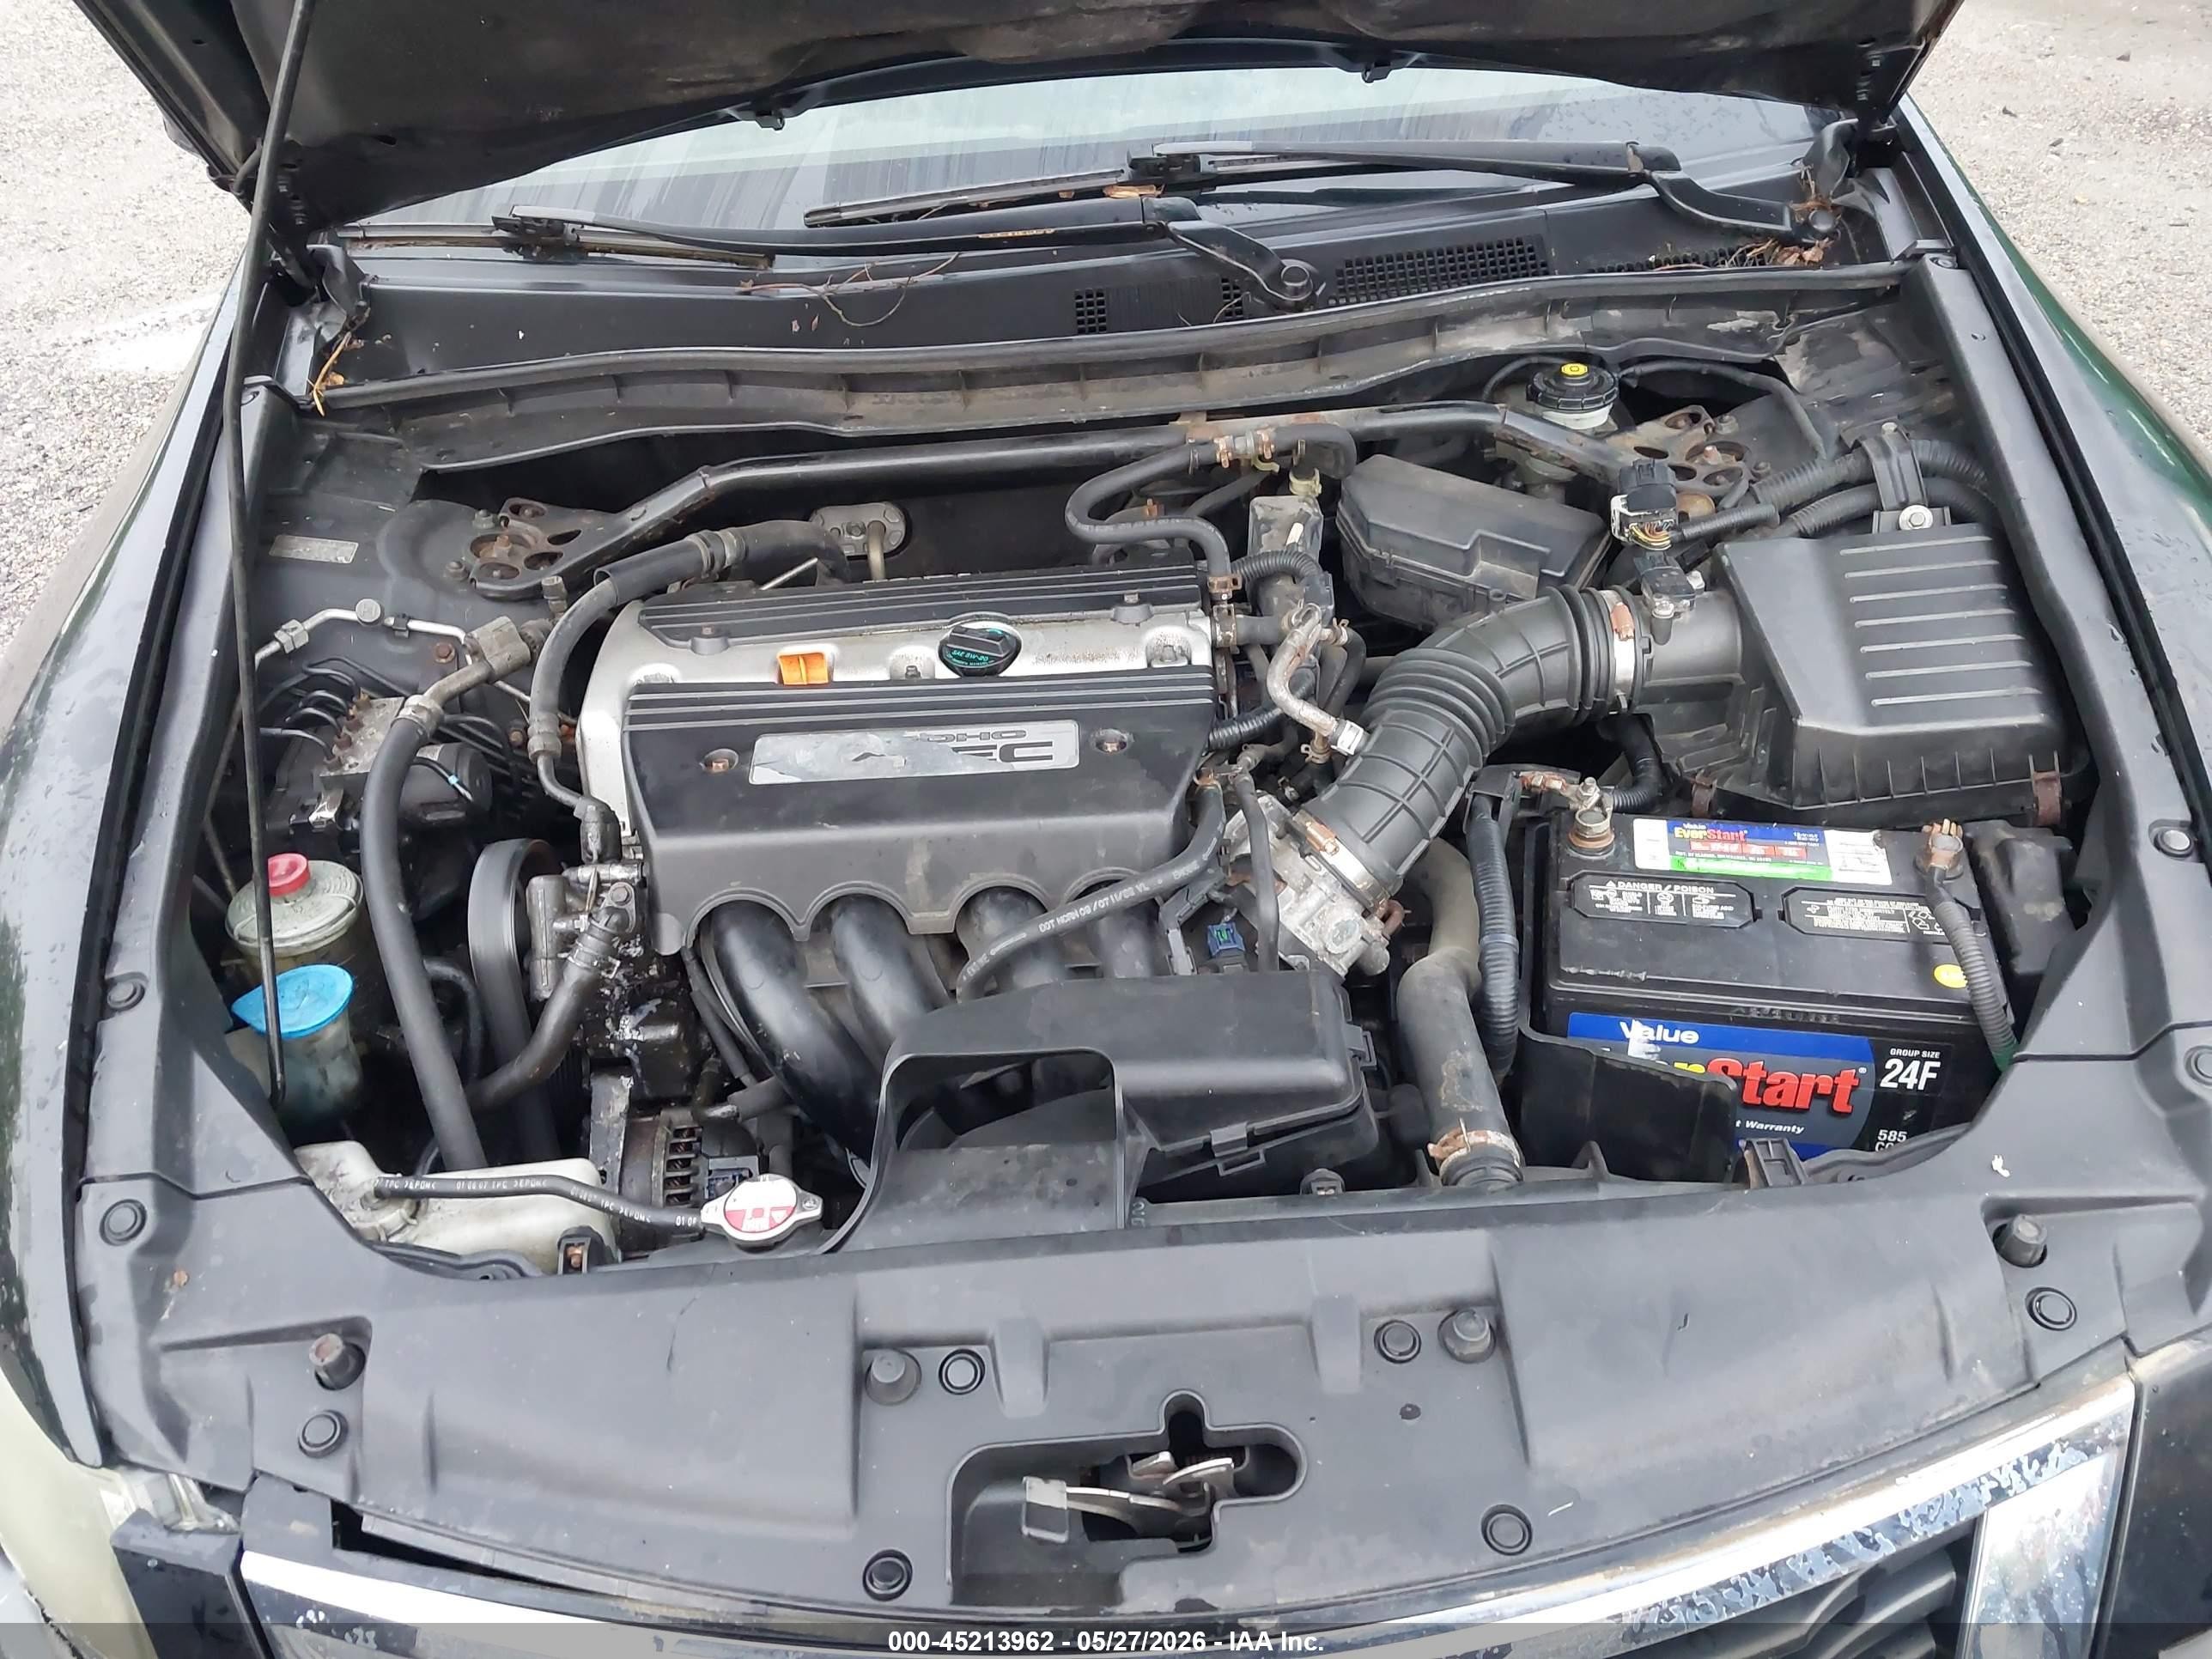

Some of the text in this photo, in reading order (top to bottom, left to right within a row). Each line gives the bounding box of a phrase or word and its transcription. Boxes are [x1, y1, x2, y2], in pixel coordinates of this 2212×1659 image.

[1618, 881, 1662, 891] DANGER
[1674, 884, 1714, 894] POISON
[1889, 1048, 1941, 1059] GROUP SIZE
[1879, 1058, 1942, 1091] 24F
[1745, 1120, 1805, 1134] Warranty
[1877, 1129, 1908, 1143] 585
